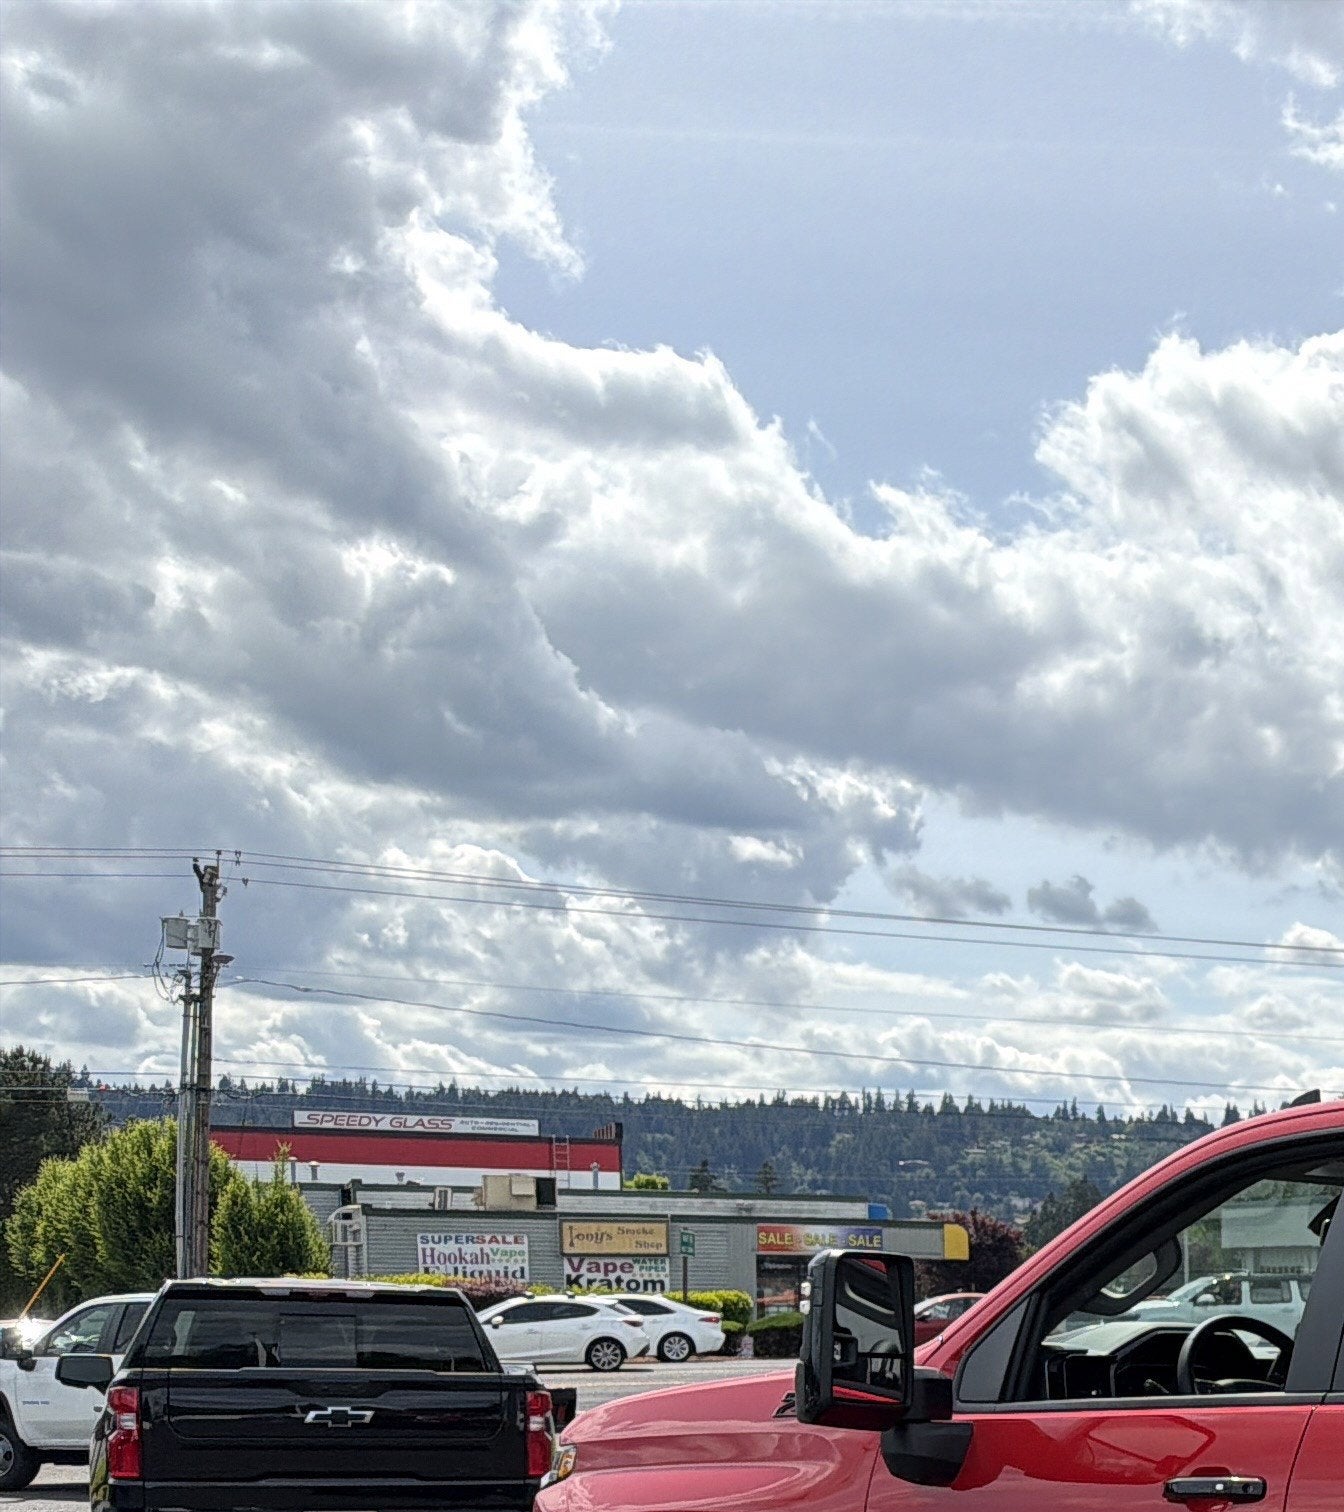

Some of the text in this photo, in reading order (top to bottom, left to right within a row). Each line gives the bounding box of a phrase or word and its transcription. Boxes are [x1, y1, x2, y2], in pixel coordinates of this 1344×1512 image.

[299, 1113, 456, 1130] SPEEDY GLASS
[617, 1226, 656, 1235] Smoke
[635, 1240, 663, 1250] Shop
[758, 1232, 881, 1248] SALE SALE SALE
[421, 1247, 526, 1265] Hookah Vape
[566, 1257, 634, 1277] Vape
[566, 1274, 666, 1292] Kratom
